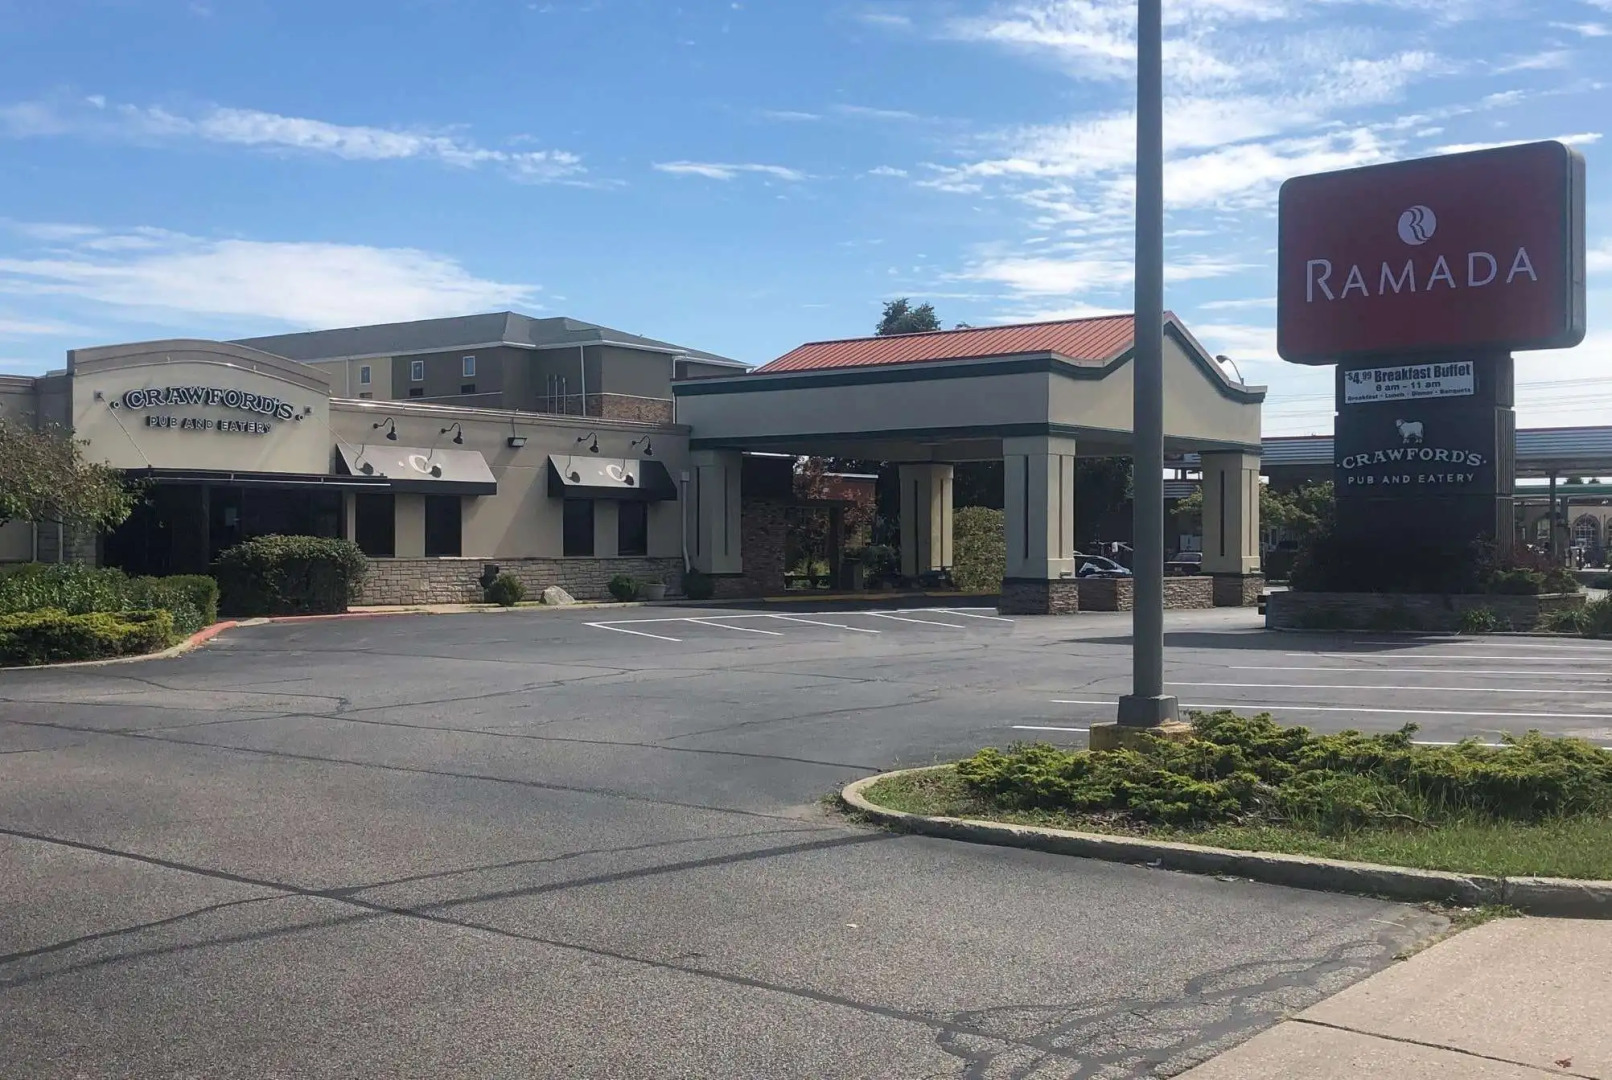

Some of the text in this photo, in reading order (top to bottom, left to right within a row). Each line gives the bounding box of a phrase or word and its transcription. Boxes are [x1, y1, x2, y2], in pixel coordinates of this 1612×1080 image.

[1306, 246, 1538, 303] RAMADA
[1375, 367, 1431, 383] Breakfast
[1434, 363, 1471, 378] Buffet
[1411, 381, 1421, 389] 11
[123, 386, 295, 421] CRAWFORD'S
[146, 415, 272, 433] PUB AND EATERY
[1342, 448, 1483, 469] CRAWFORD'S
[1348, 473, 1474, 484] PUB AND EATERY
